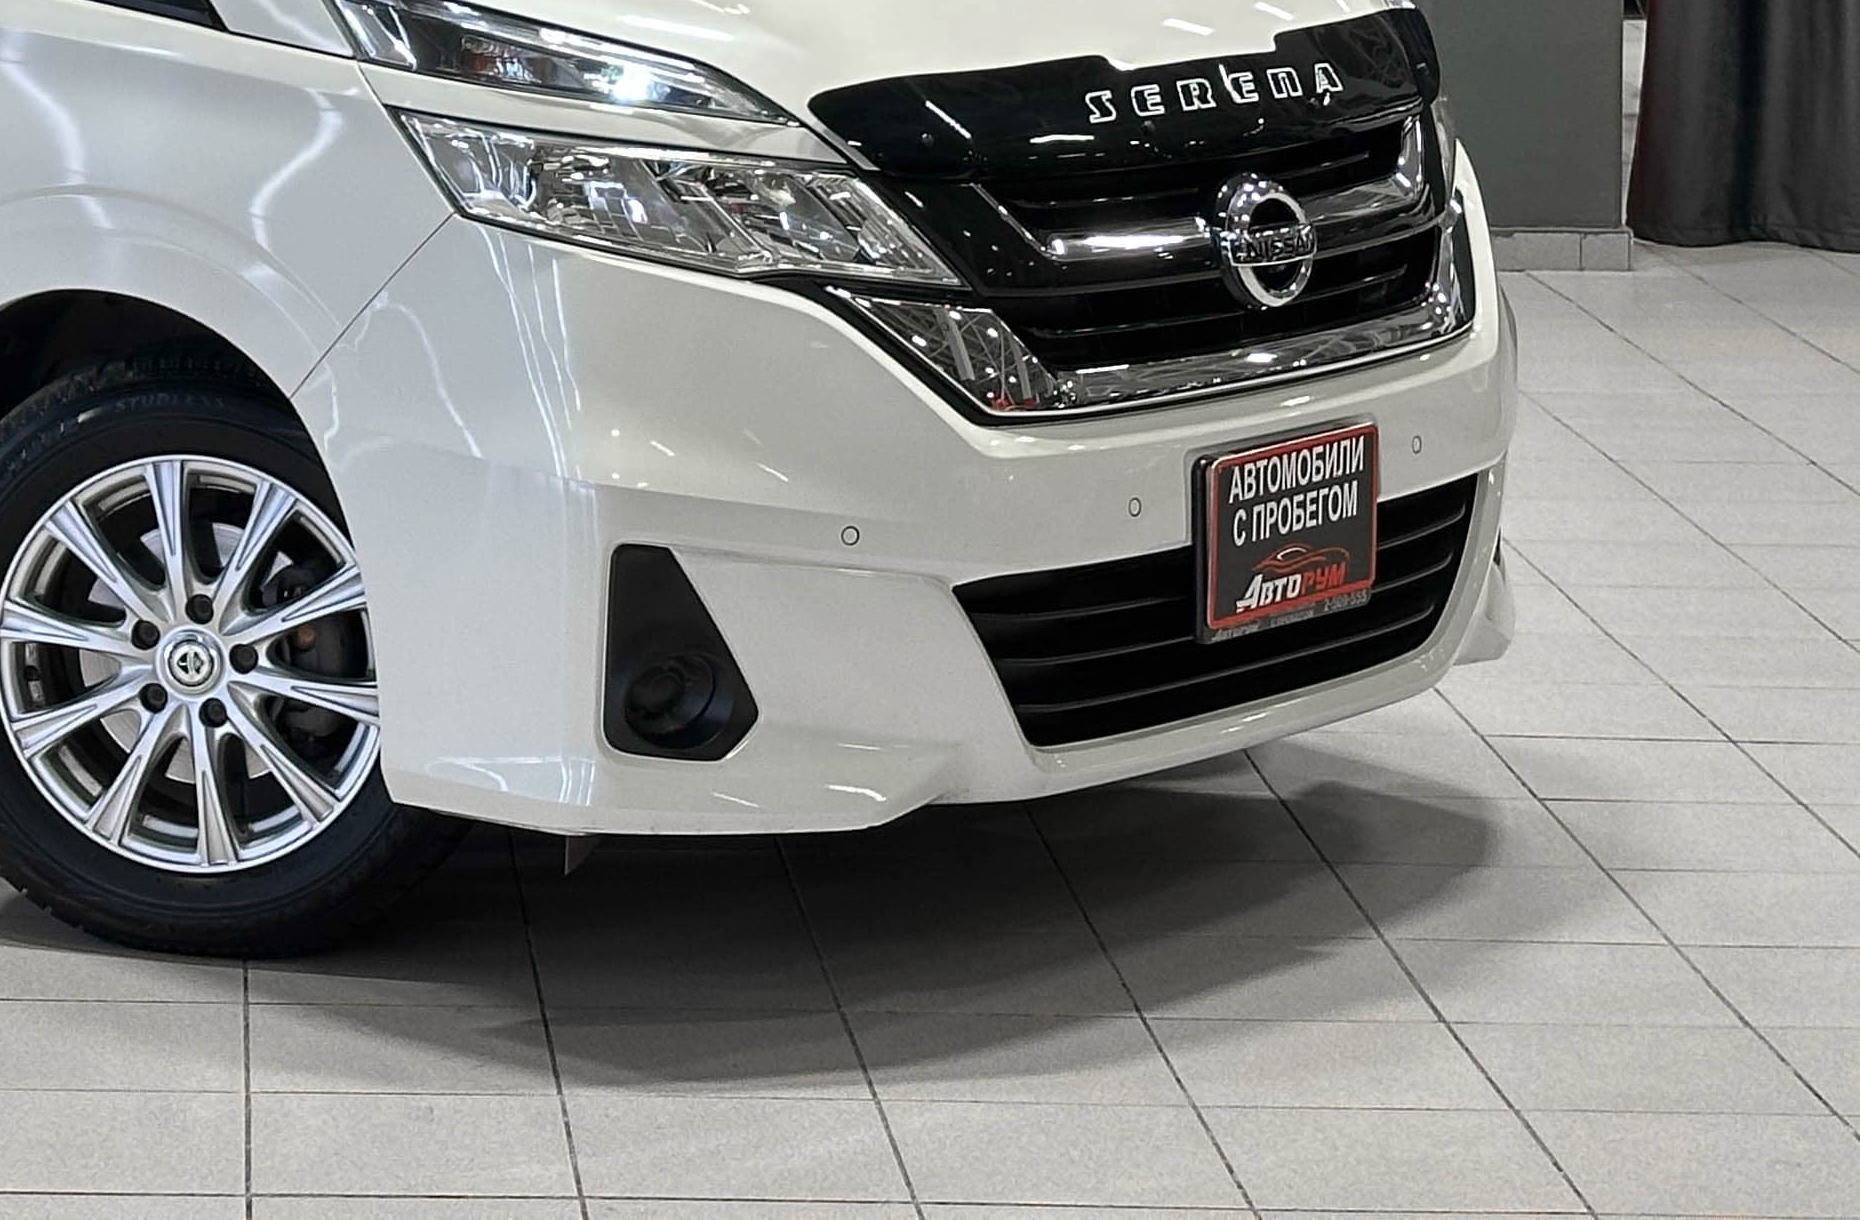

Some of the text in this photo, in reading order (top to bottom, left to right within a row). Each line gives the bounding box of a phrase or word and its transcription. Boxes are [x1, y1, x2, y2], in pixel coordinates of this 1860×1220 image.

[1084, 62, 1343, 124] SERENA
[1243, 229, 1315, 263] NISSAN
[1229, 435, 1365, 504] АВТОМОБИЛИ
[1233, 480, 1358, 547] С ПРОБЕГОМ
